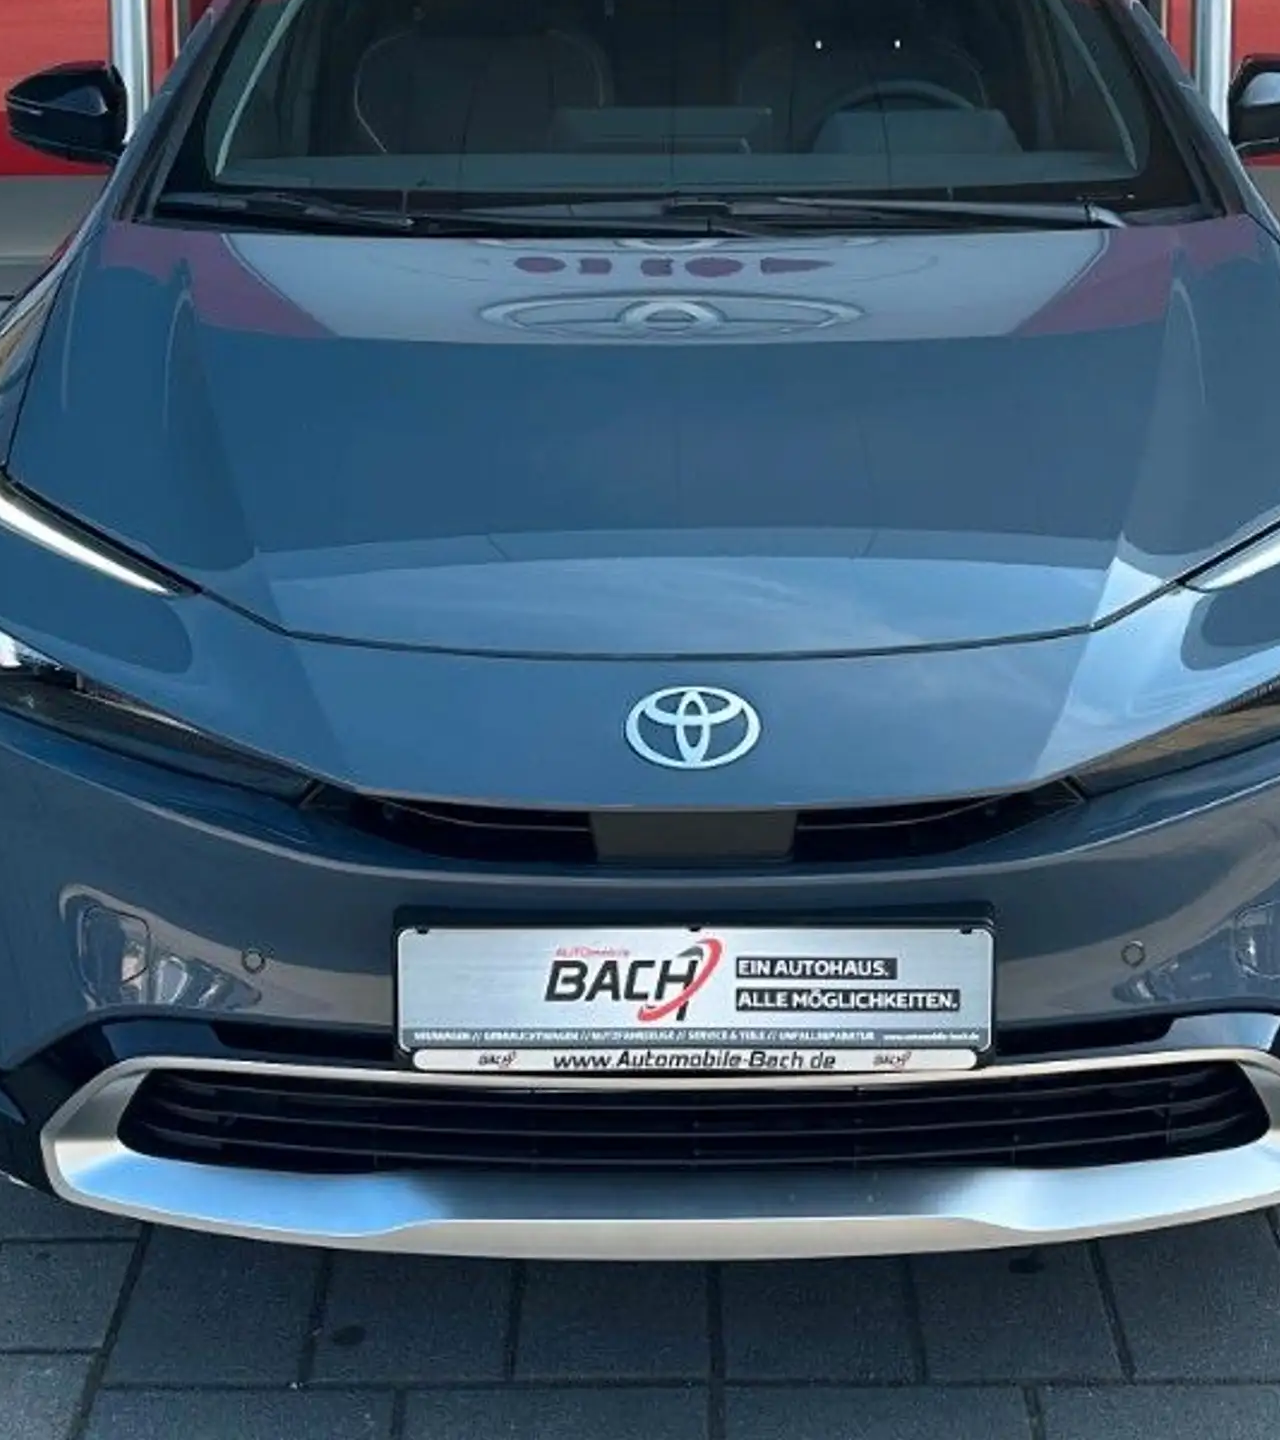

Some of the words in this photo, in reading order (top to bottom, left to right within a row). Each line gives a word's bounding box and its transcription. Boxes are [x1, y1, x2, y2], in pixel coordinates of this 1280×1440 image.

[738, 960, 770, 977] EIN
[773, 959, 890, 977] AUTOHAUS.
[545, 953, 704, 1017] BACH
[738, 991, 788, 1009] ALLE
[792, 988, 959, 1009] MÖGLICHKEITEN.
[553, 1049, 836, 1070] www.Automobile-Bach.de
